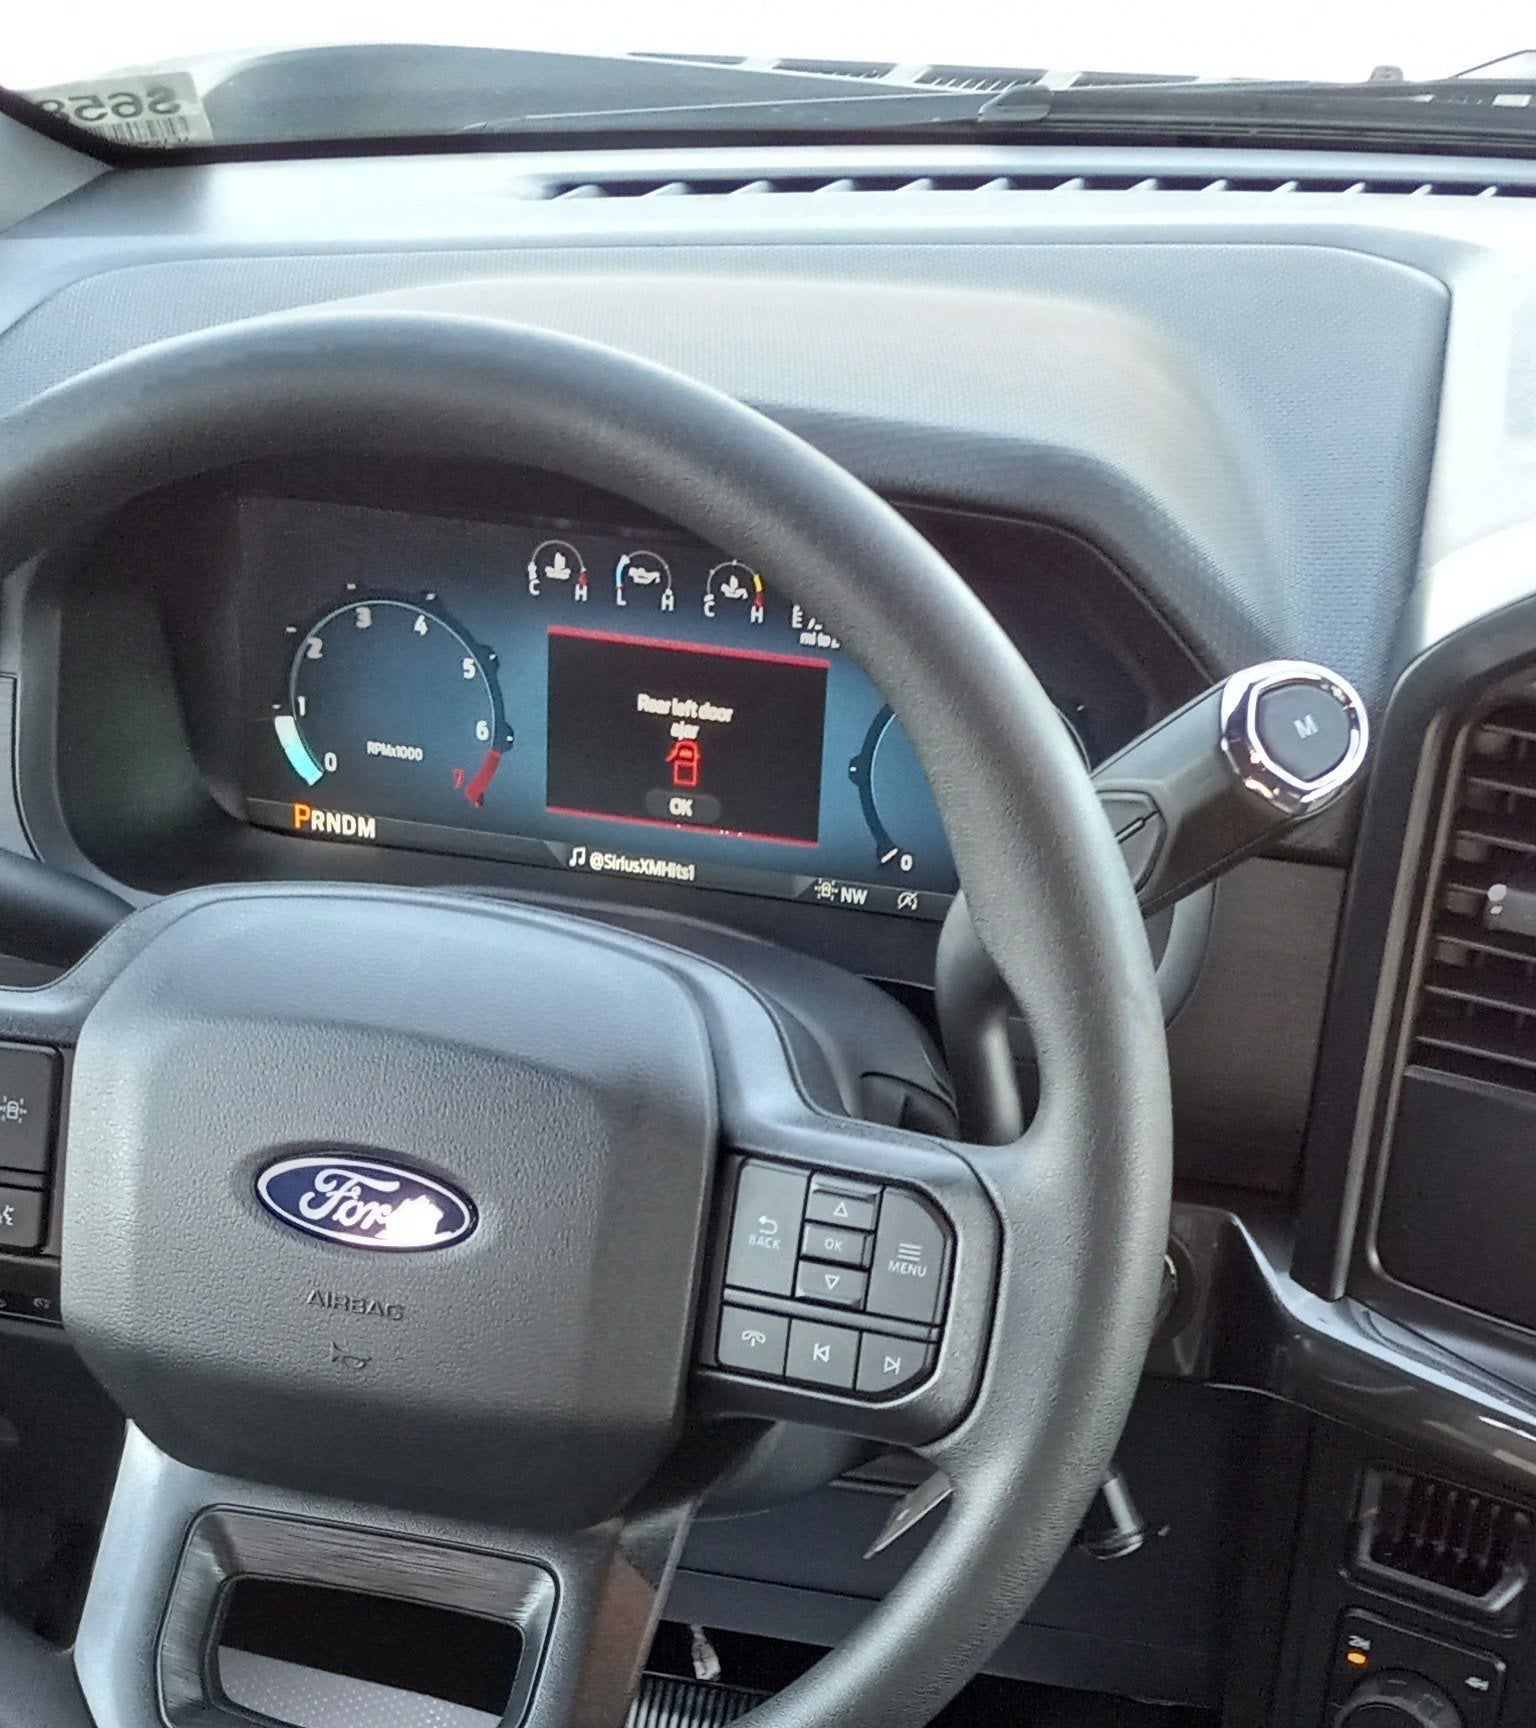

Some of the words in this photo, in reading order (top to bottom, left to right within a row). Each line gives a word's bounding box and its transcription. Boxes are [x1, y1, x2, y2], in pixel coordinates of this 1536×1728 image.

[529, 579, 540, 595] C
[575, 584, 588, 601] H
[355, 607, 372, 628] 3
[751, 606, 763, 623] H
[414, 615, 428, 635] 4
[306, 637, 324, 659] 2
[463, 658, 476, 679] 5
[297, 696, 306, 716] 1
[637, 693, 671, 714] Rear
[672, 698, 698, 718] left
[699, 702, 734, 722] door
[476, 720, 489, 741] 6
[670, 721, 700, 740] ajar
[1293, 714, 1319, 740] M
[324, 752, 337, 772] 0
[669, 798, 693, 816] OK
[589, 852, 696, 881] @SiriusXMHits1
[900, 854, 913, 871] 0
[840, 886, 868, 905] NW
[749, 1234, 782, 1250] BACK
[824, 1239, 843, 1252] OK
[888, 1261, 927, 1277] MENU
[306, 1289, 404, 1322] AIRBAG
